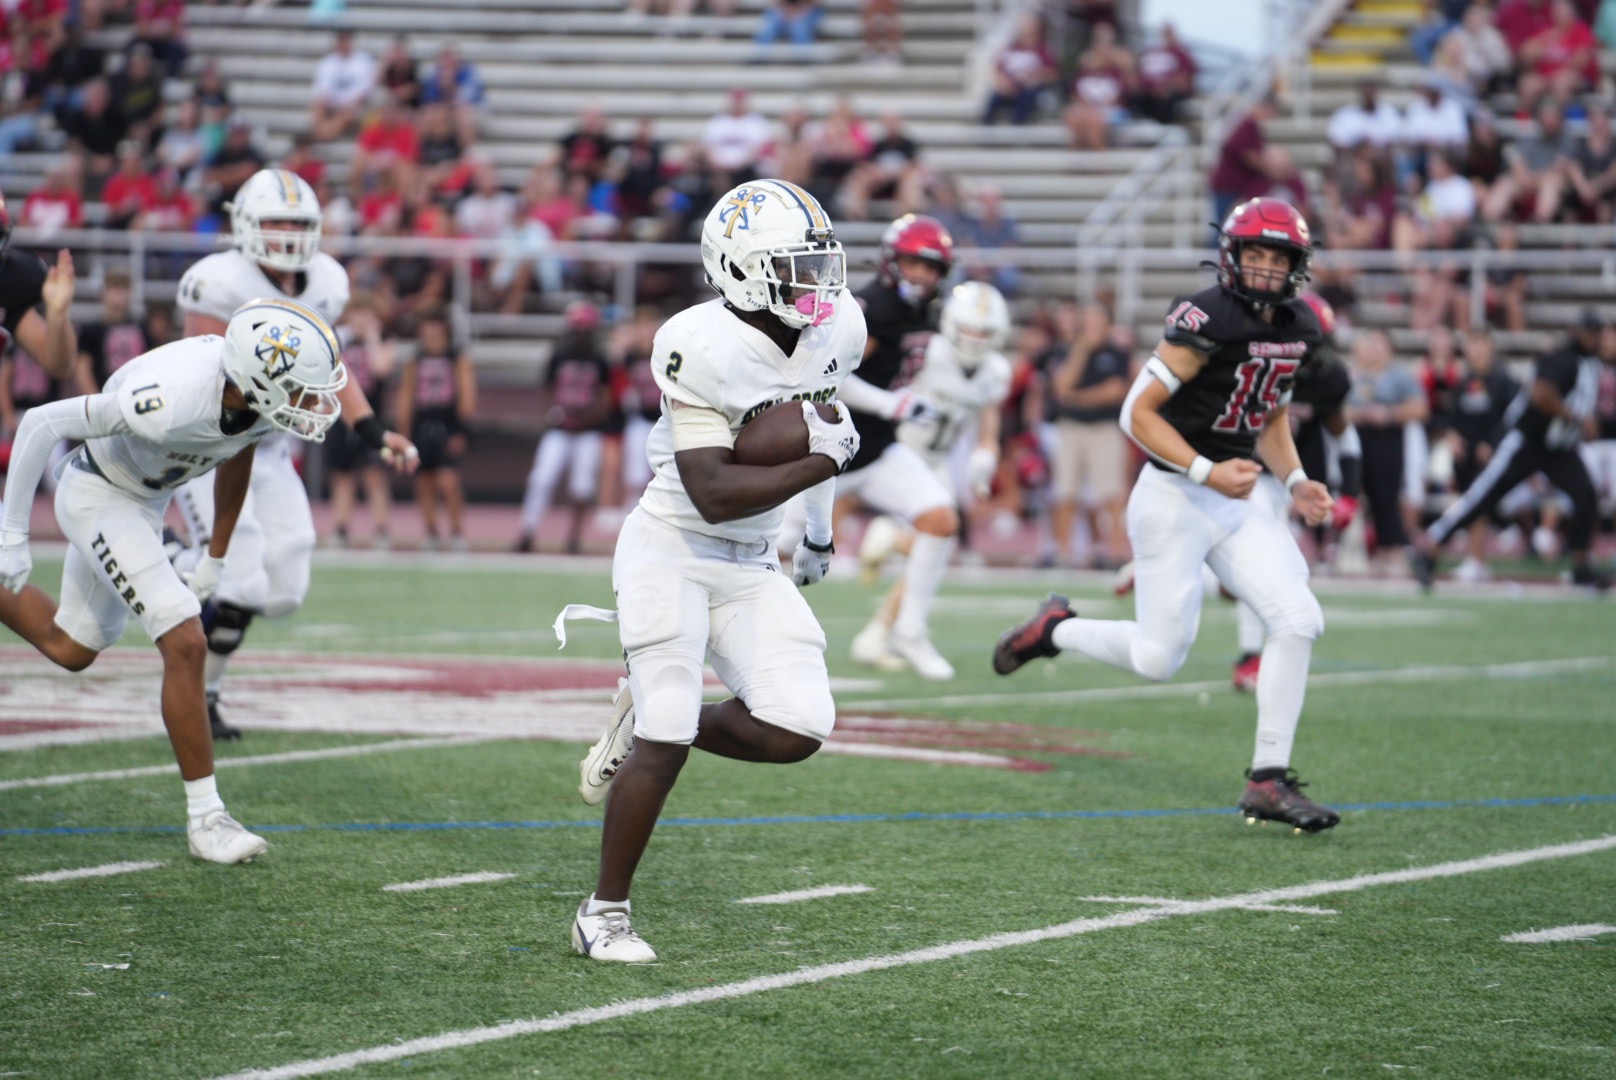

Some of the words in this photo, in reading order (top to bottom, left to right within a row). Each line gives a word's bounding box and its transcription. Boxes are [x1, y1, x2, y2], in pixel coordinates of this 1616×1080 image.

[1166, 301, 1210, 332] 15
[666, 351, 683, 384] 2
[132, 383, 164, 415] 19
[1212, 357, 1302, 433] 15
[92, 532, 145, 616] TIGERS
